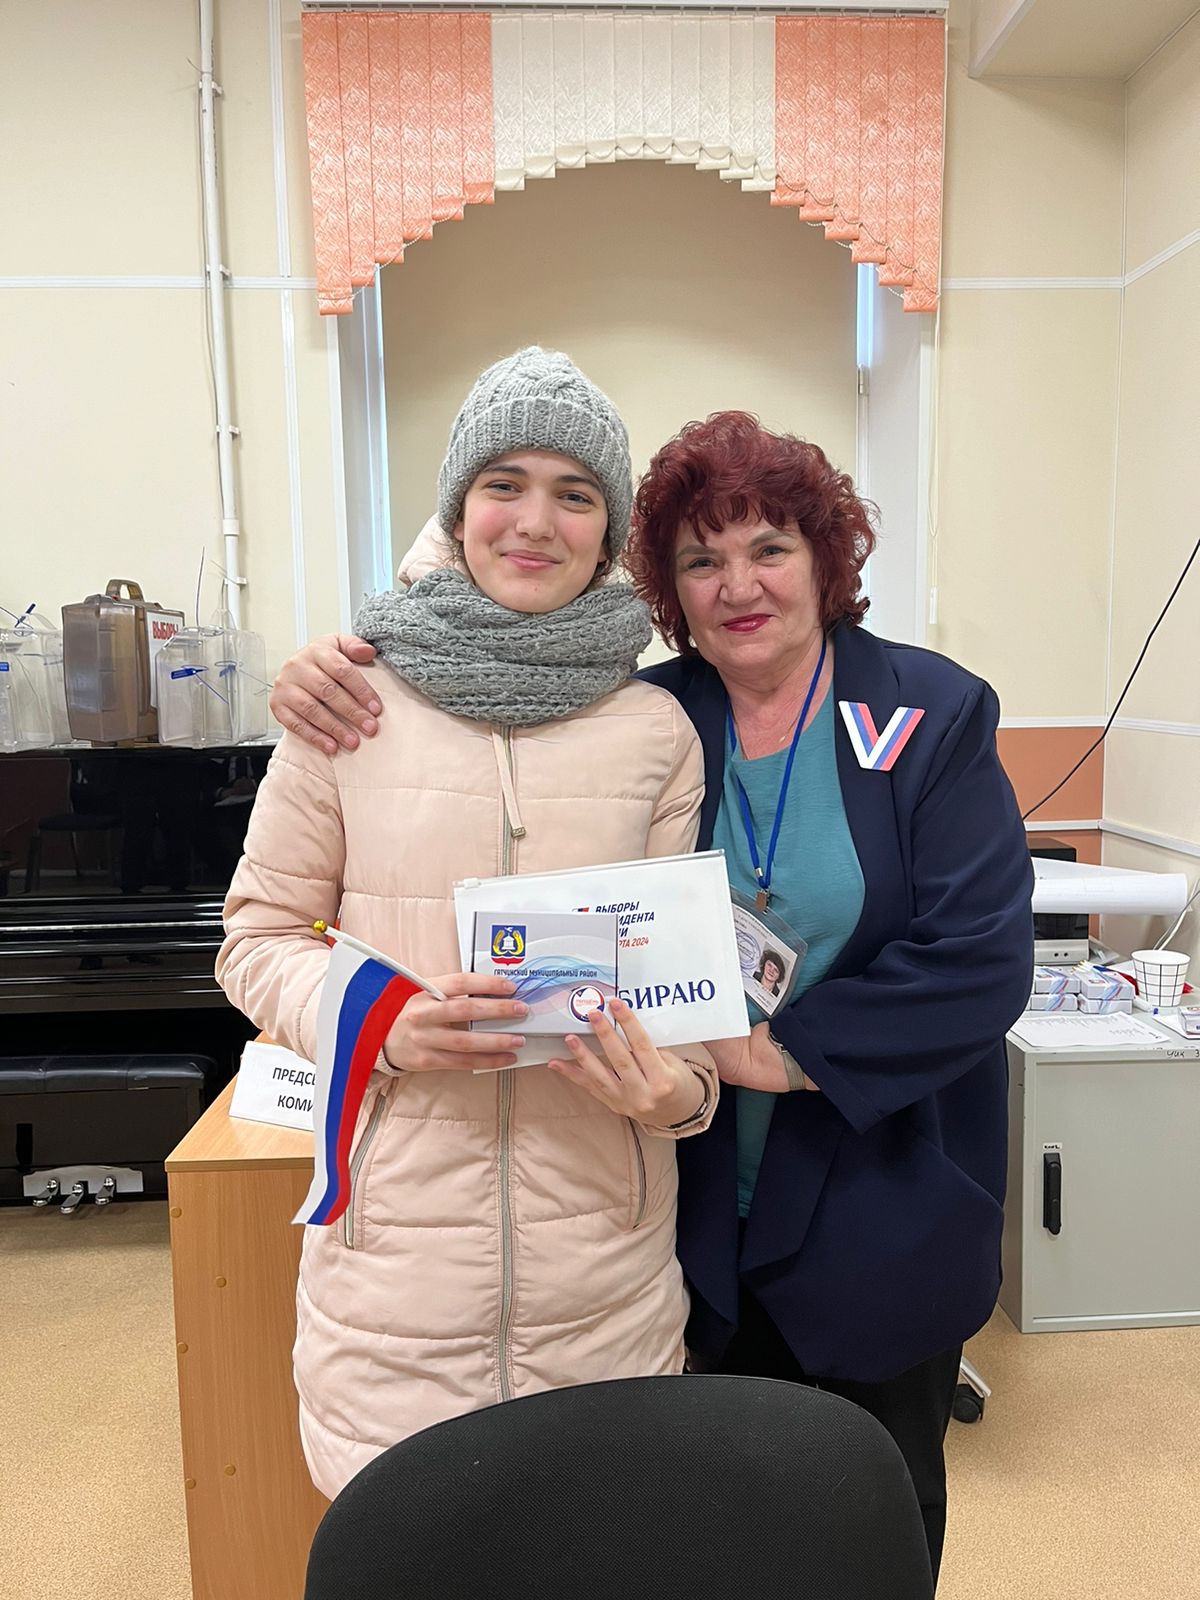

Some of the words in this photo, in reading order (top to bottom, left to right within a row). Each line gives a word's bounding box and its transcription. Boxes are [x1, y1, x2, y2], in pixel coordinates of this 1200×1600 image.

[595, 901, 640, 913] ВЫБОРЫ
[631, 936, 649, 947] 2024
[579, 969, 598, 978] РАЙОН
